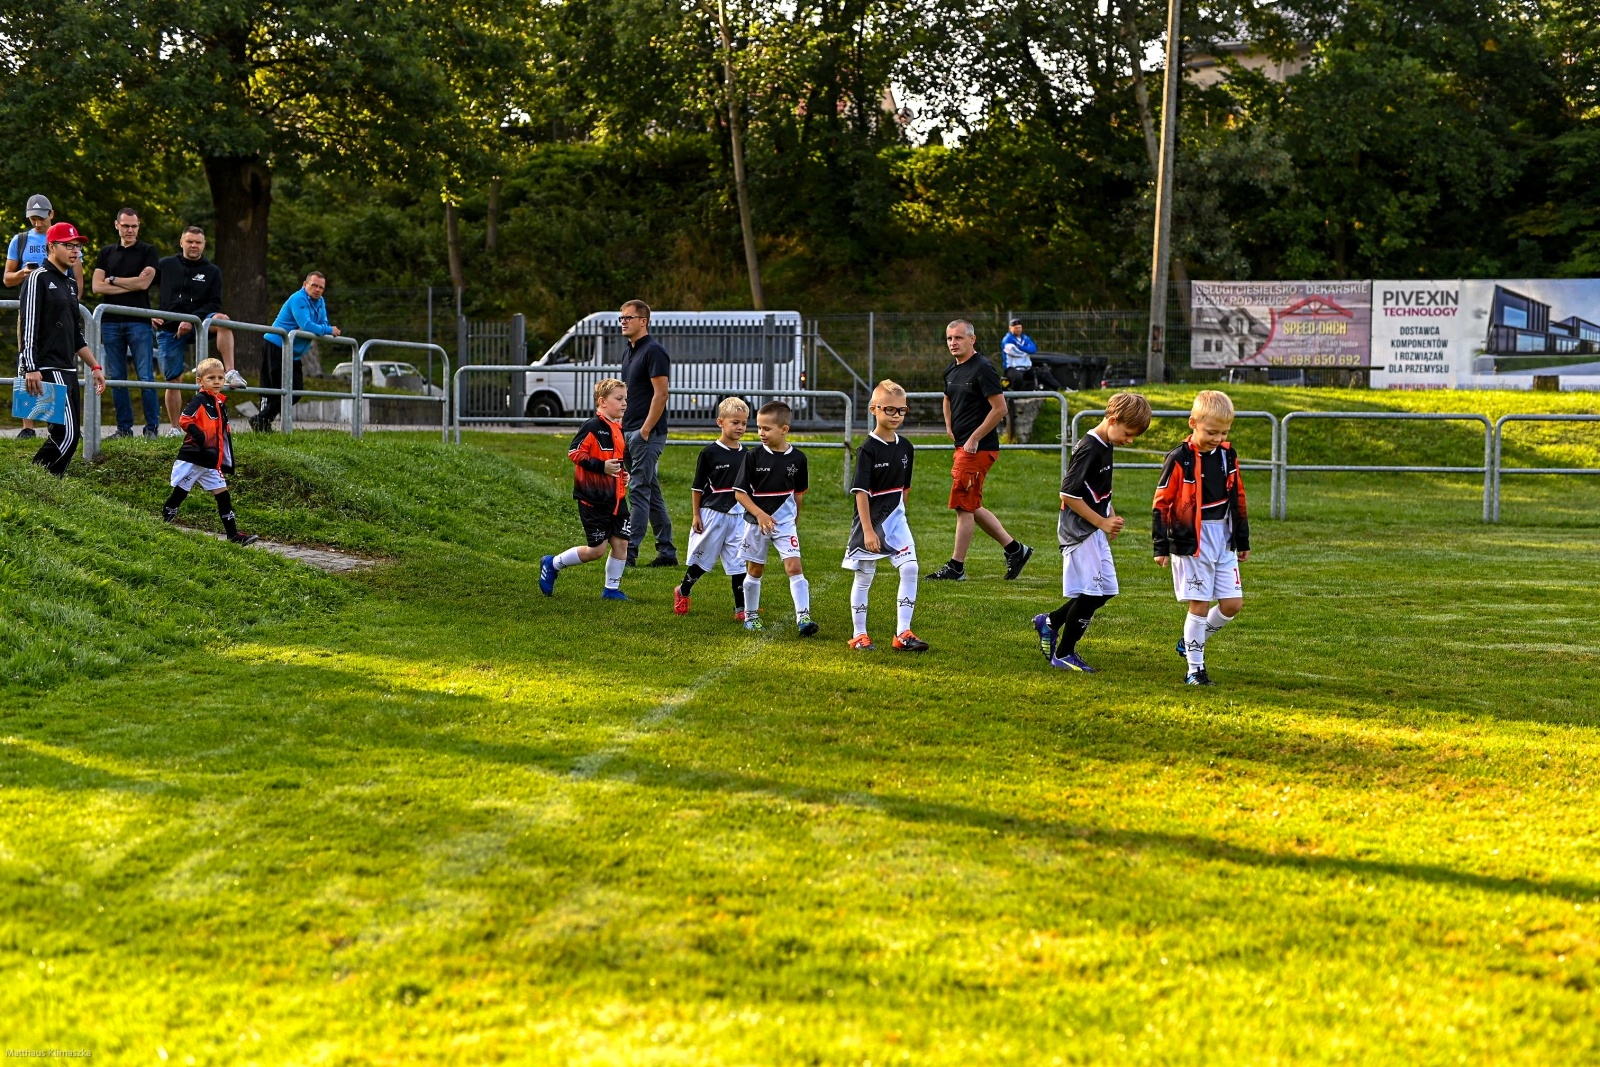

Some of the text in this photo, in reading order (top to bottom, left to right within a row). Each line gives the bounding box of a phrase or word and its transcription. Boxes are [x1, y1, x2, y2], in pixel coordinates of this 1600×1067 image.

[29, 245, 41, 254] BIG
[1235, 284, 1298, 295] CIESIELSKO
[1305, 283, 1368, 294] DEKARSKIE
[1382, 290, 1459, 306] PIVEXIN
[1383, 307, 1459, 317] TECHNOLOGY
[1399, 326, 1440, 336] DOSTAWCA
[1390, 337, 1449, 349] KOMPONENTÓW
[1313, 354, 1336, 366] 650
[1338, 354, 1361, 366] 692
[1400, 350, 1444, 362] ROZWIĄZAŃ
[1388, 364, 1449, 374] DLA PRZEMYSŁU
[789, 535, 799, 548] 6
